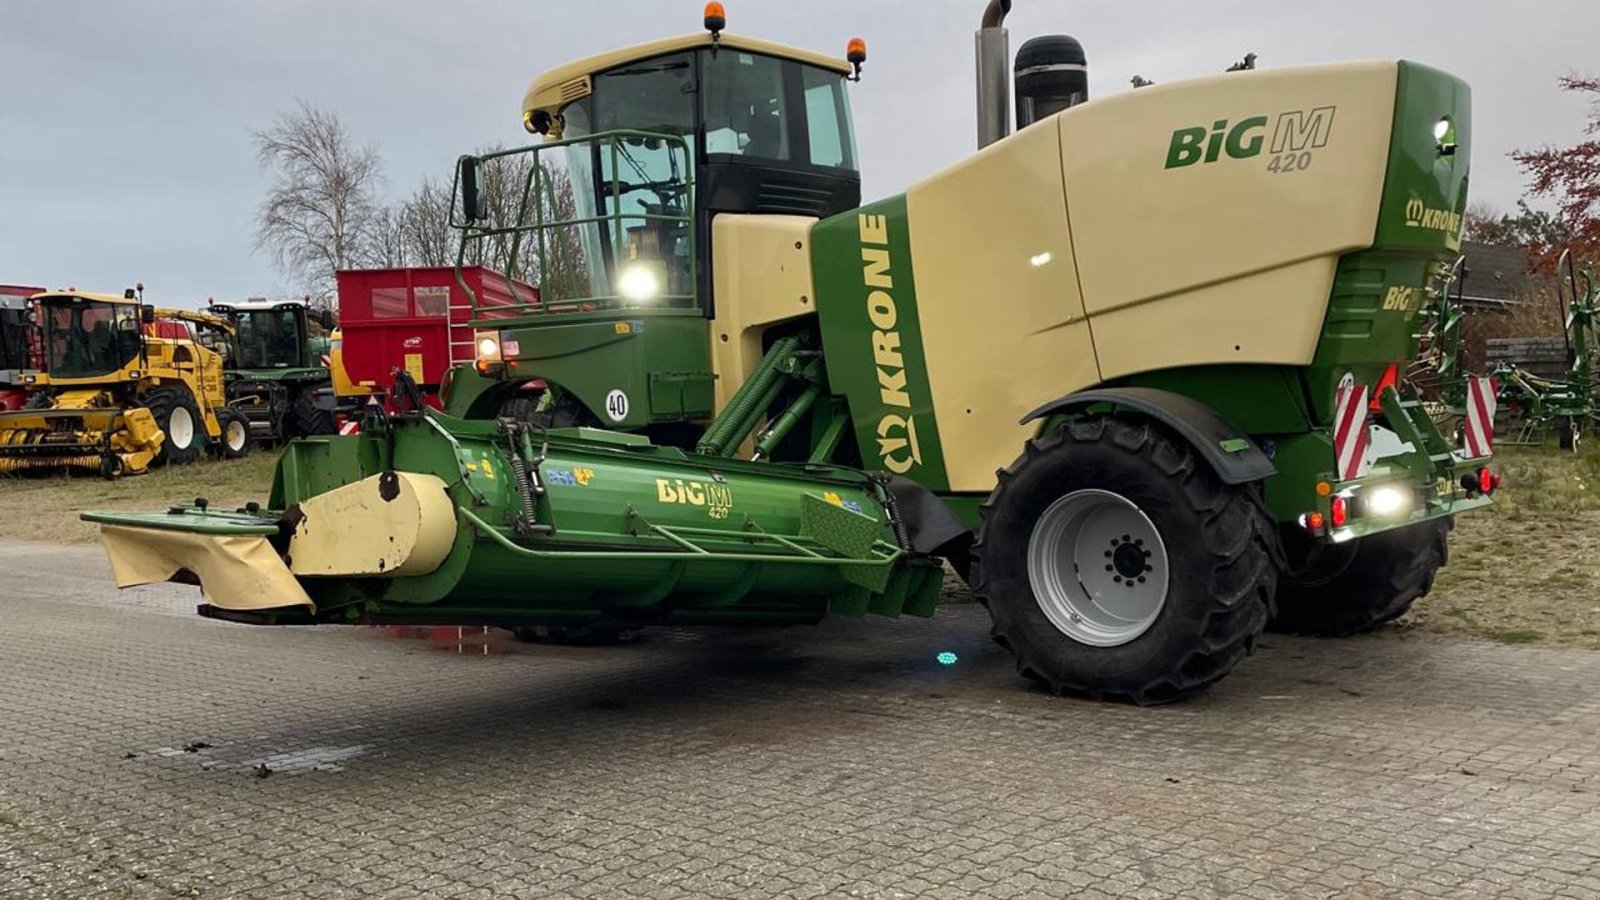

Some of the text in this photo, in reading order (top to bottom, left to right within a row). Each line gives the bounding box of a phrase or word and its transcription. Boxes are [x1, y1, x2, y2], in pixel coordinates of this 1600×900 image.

[1267, 151, 1312, 174] 420
[858, 213, 911, 408] KRONE
[609, 394, 625, 416] 40
[708, 507, 729, 519] 420
